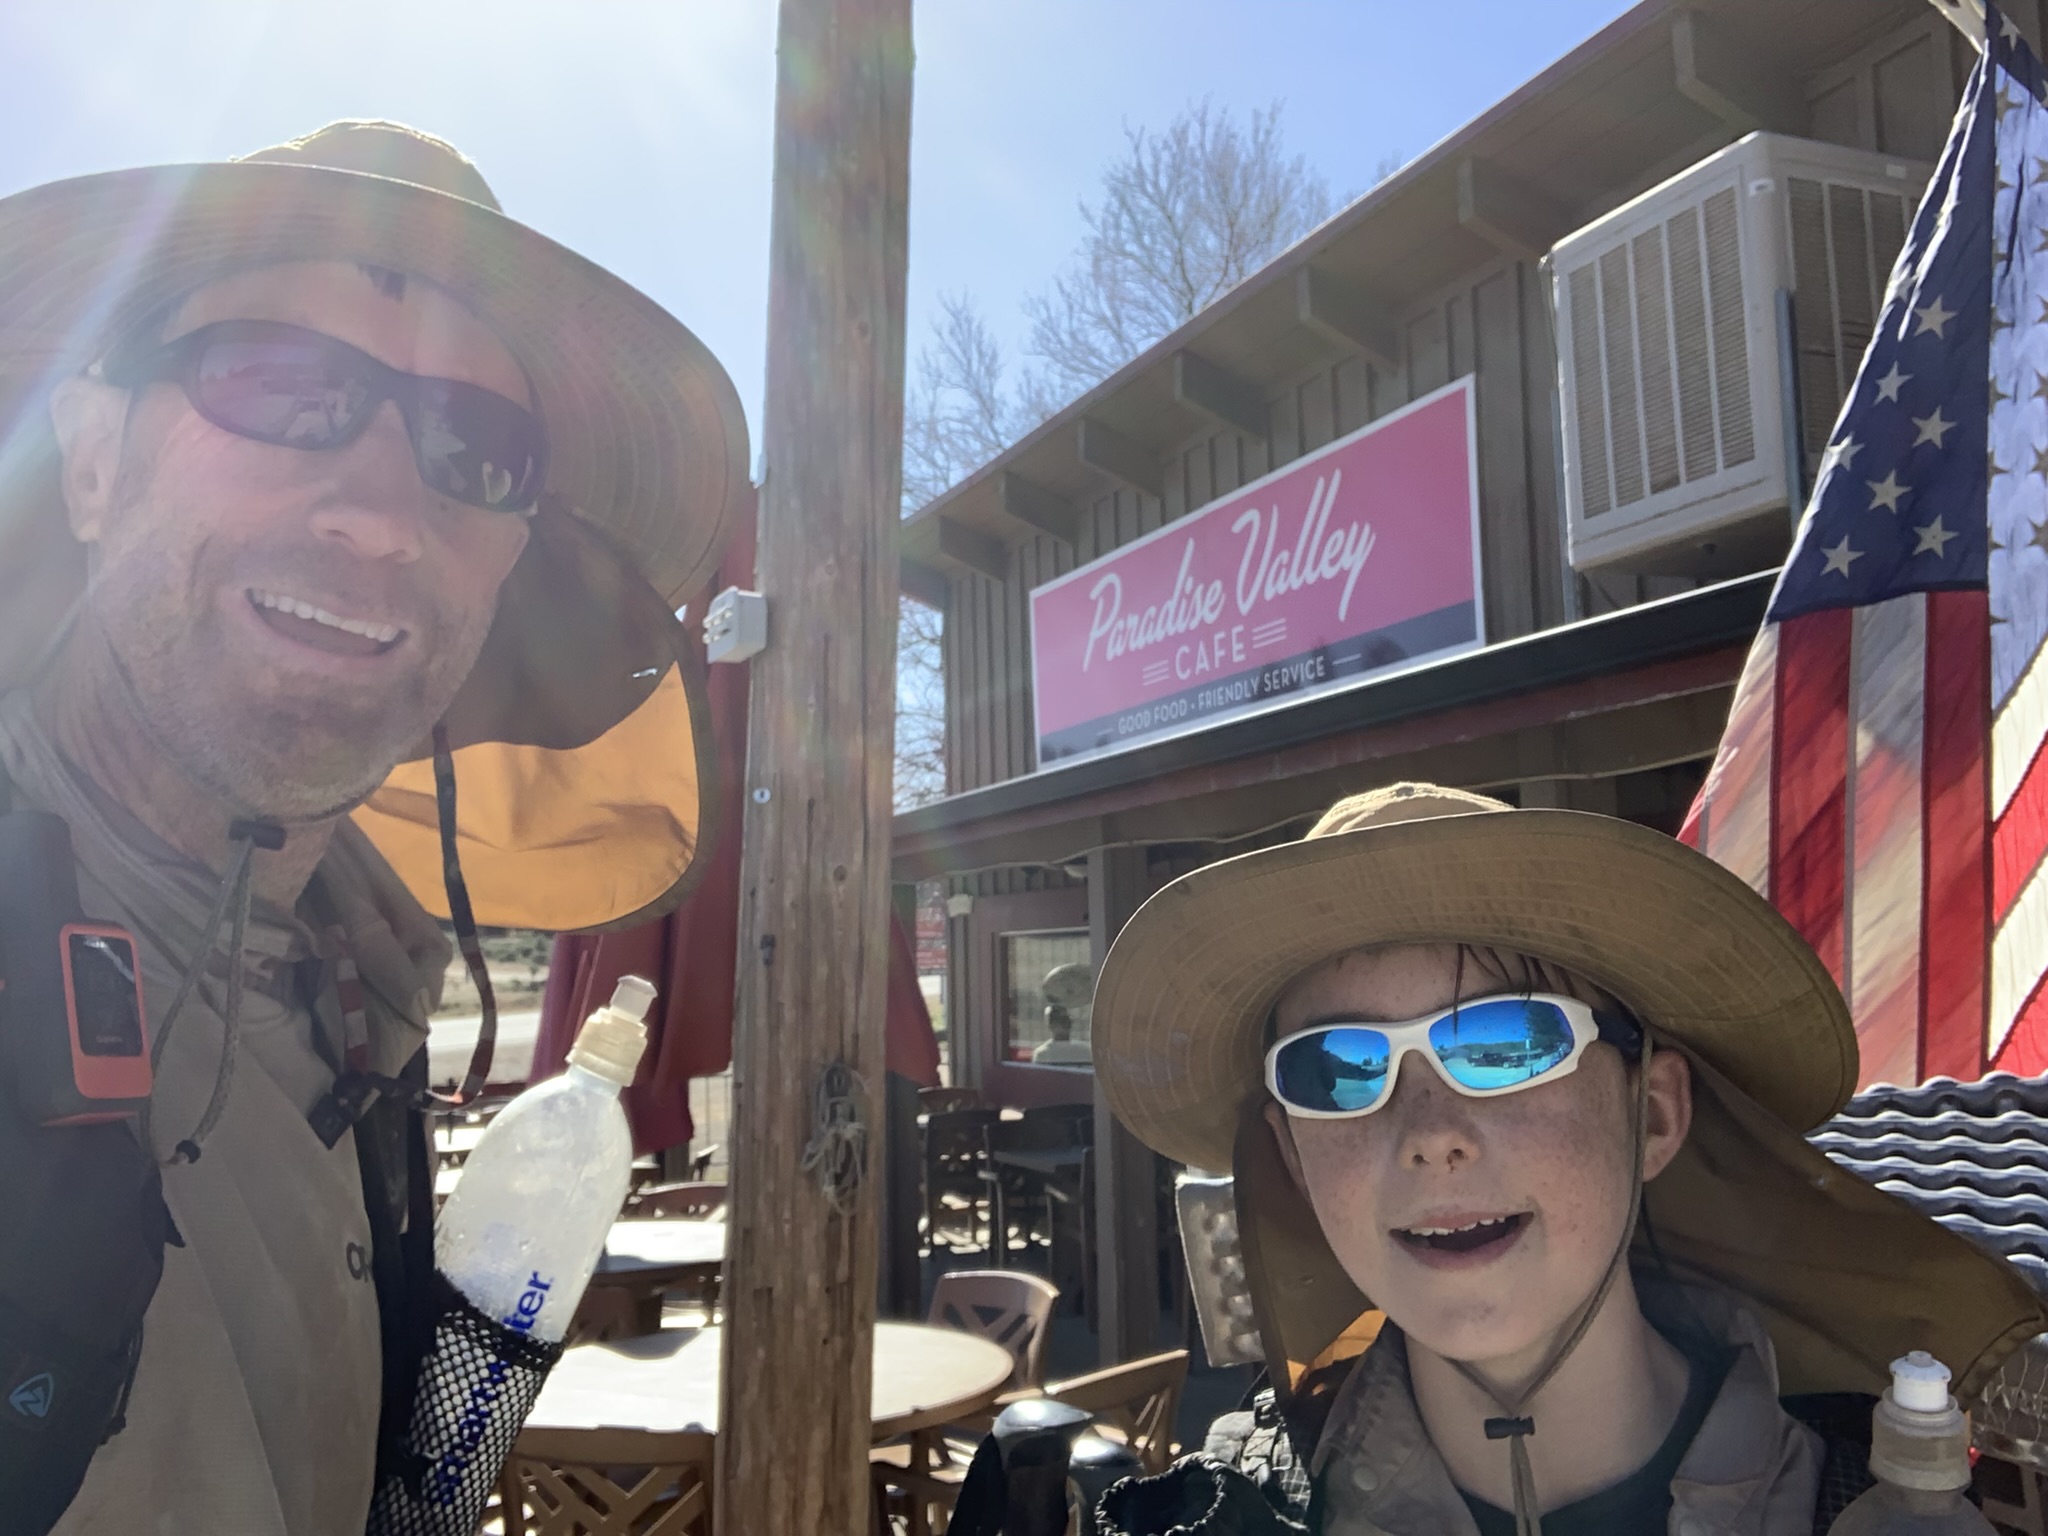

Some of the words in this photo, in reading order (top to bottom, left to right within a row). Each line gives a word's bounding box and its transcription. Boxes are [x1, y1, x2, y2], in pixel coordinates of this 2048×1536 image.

[1083, 537, 1224, 672] Paradise
[1231, 468, 1376, 622] Valley
[1175, 625, 1246, 680] CAFE
[1118, 711, 1150, 735] GOOD
[1154, 699, 1187, 724] FOOD
[1198, 678, 1259, 710] FRIENDLY
[1264, 655, 1325, 692] SERVICE
